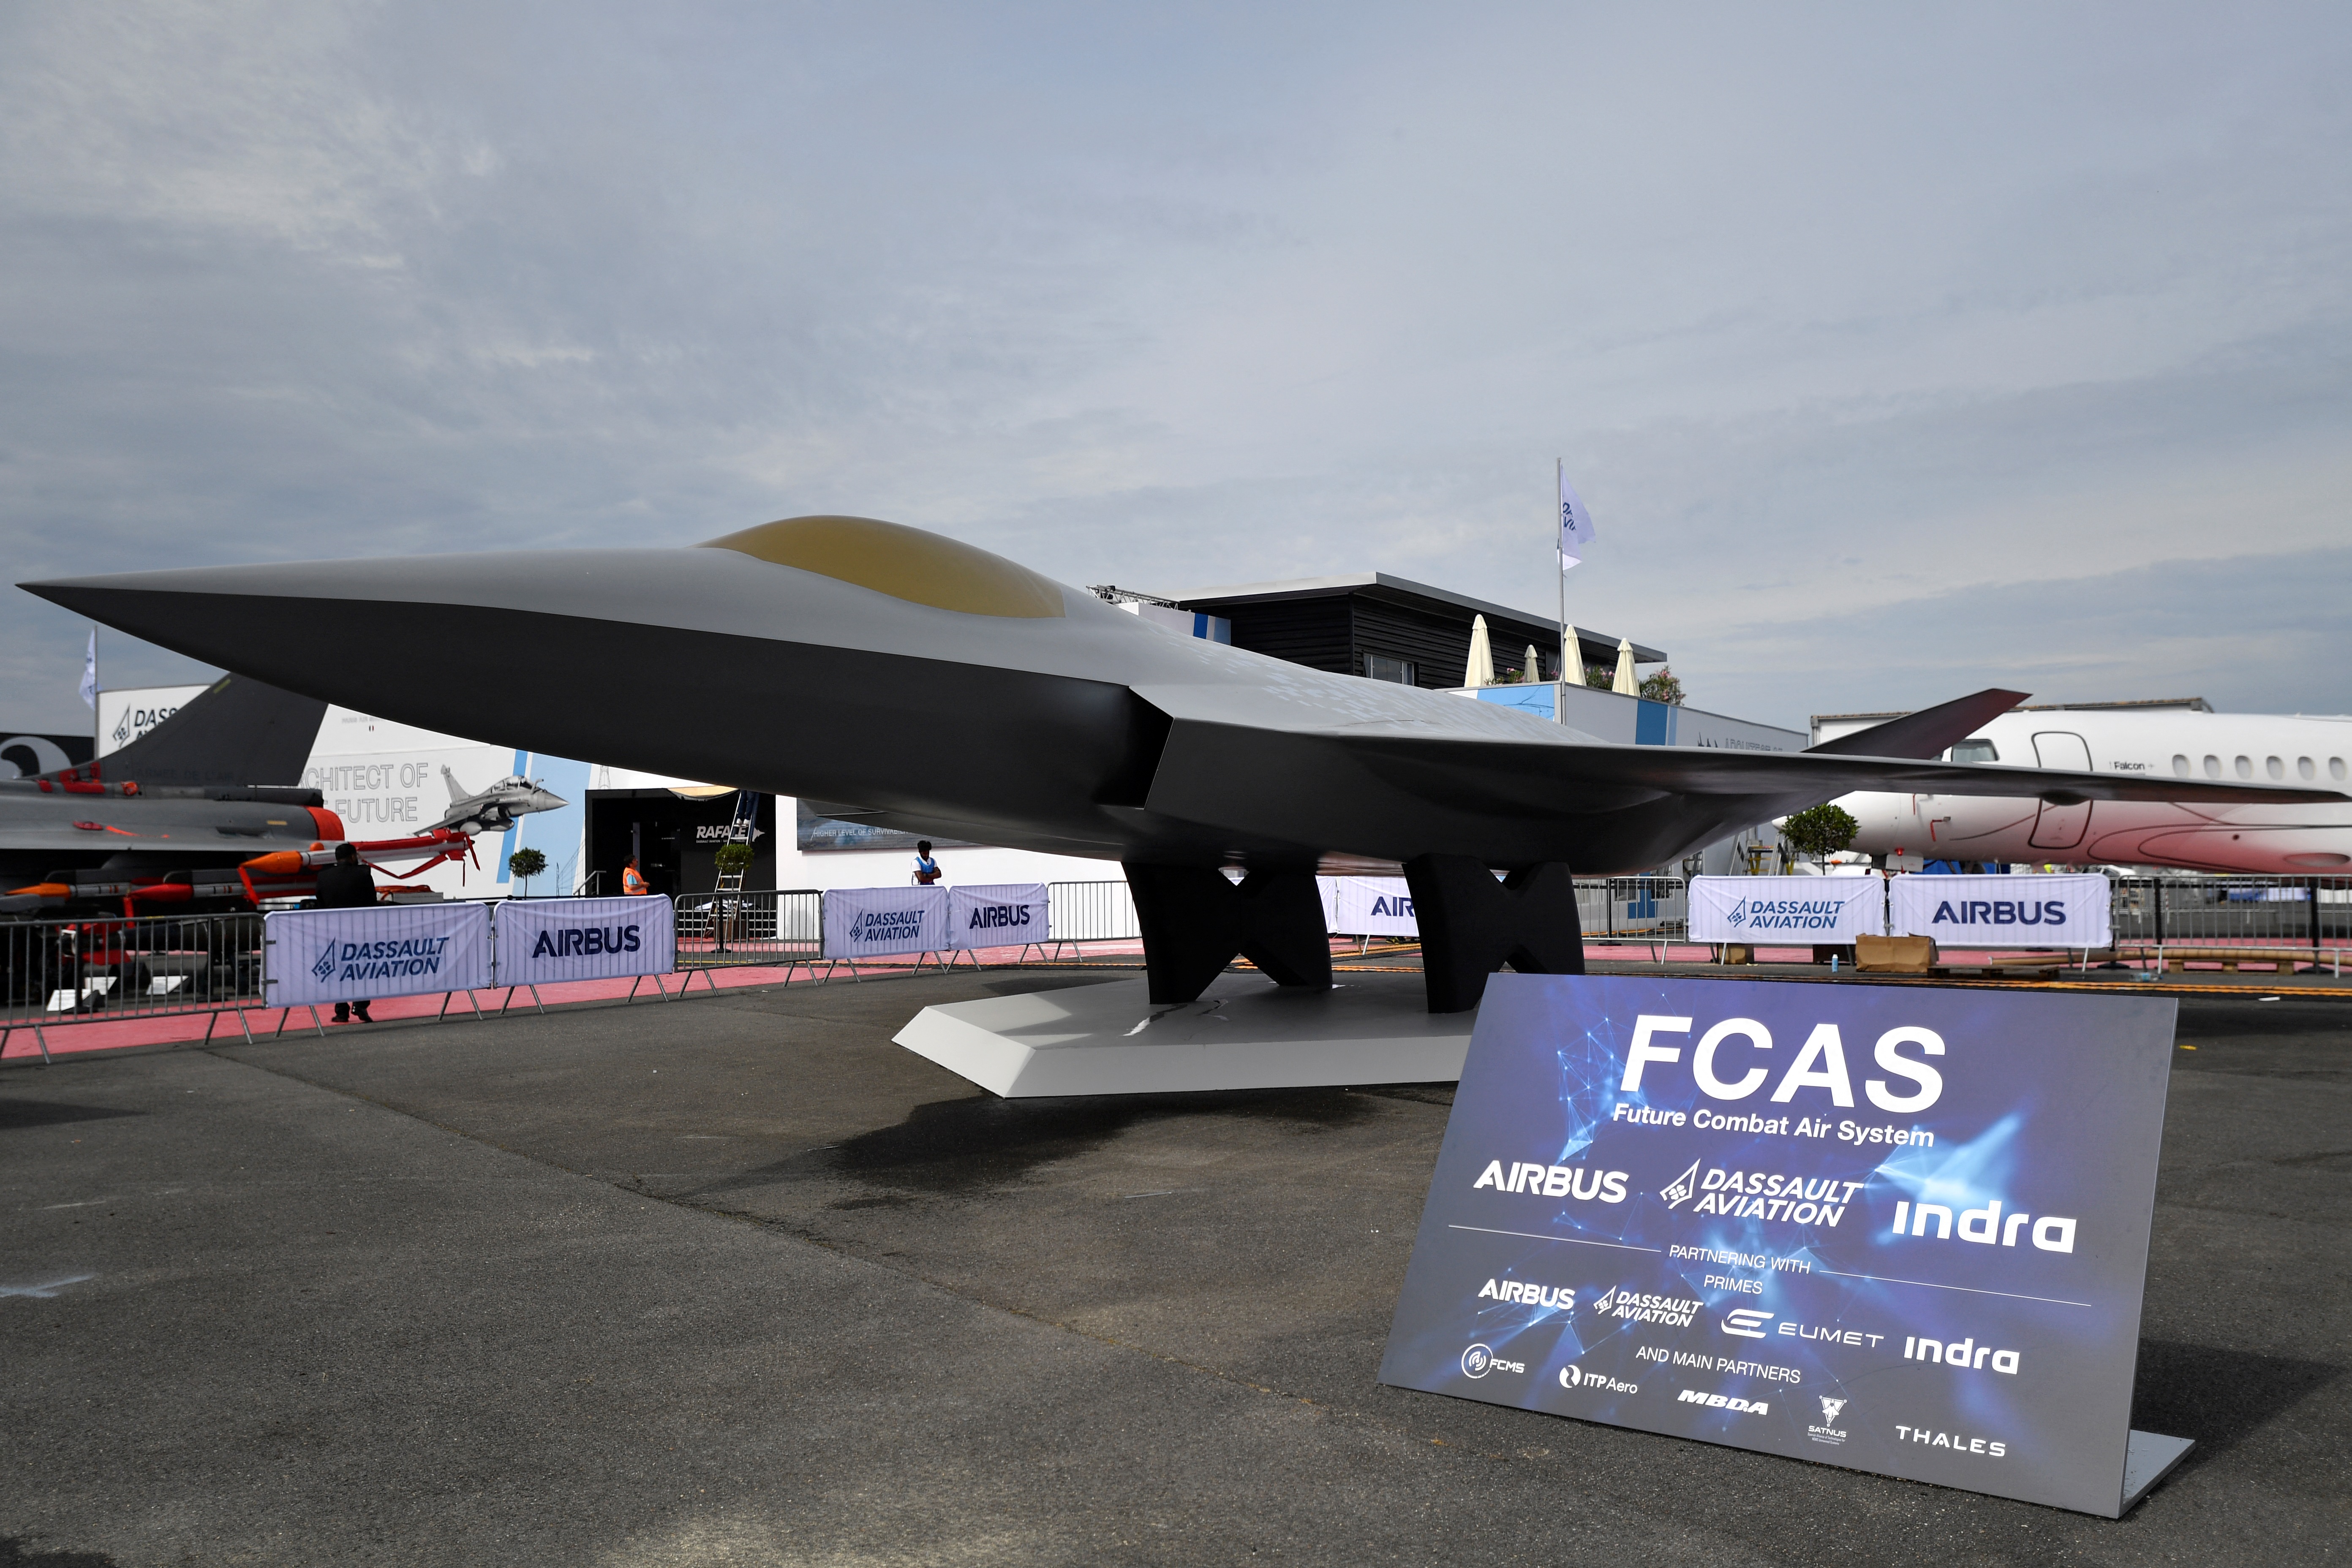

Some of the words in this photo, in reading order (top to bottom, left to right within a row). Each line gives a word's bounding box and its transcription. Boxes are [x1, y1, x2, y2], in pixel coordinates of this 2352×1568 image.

[299, 764, 393, 791] CHITECT
[400, 762, 428, 788] OF
[2114, 760, 2145, 770] Falcon
[336, 797, 418, 823] FUTURE
[697, 825, 746, 838] RAFAE
[866, 910, 925, 927] DASSAULT
[969, 905, 1030, 929] AIRBUS
[1370, 896, 1415, 917] AIR
[1750, 901, 1845, 914] DASSAULT
[1931, 900, 2066, 925] AIRBUS
[865, 925, 920, 942] AVIATION
[1749, 916, 1837, 928] AVIATION
[341, 937, 449, 961] DASSAULT
[532, 925, 641, 958] AIRBUS
[340, 957, 440, 982] AVIATION
[1620, 1015, 1946, 1113] FCAS
[1613, 1103, 1686, 1126] Future
[1693, 1109, 1789, 1135] Combat
[1794, 1115, 1831, 1138] Air
[1838, 1121, 1934, 1147] System
[1473, 1160, 1629, 1203] AIRBUS
[1701, 1169, 1864, 1203] DASSAULT
[1693, 1193, 1845, 1227] AVIATION
[1892, 1200, 2077, 1254] indra
[1669, 1244, 1766, 1269] PARTNERING
[1771, 1257, 1811, 1274] WITH
[1478, 1279, 1576, 1310] AIRBUS
[1704, 1275, 1763, 1294] PRIMES
[1617, 1291, 1704, 1315] DASSAULT
[1612, 1306, 1693, 1327] AVIATION
[1778, 1322, 1884, 1348] EUMET
[1489, 1358, 1525, 1373] FCMS
[1636, 1346, 1669, 1362] AND
[1673, 1351, 1713, 1369] MAIN
[1716, 1358, 1801, 1383] PARTNERS
[1904, 1337, 2020, 1375] indra
[1808, 1425, 1847, 1437] SATNUS
[1895, 1426, 2006, 1456] THALES
